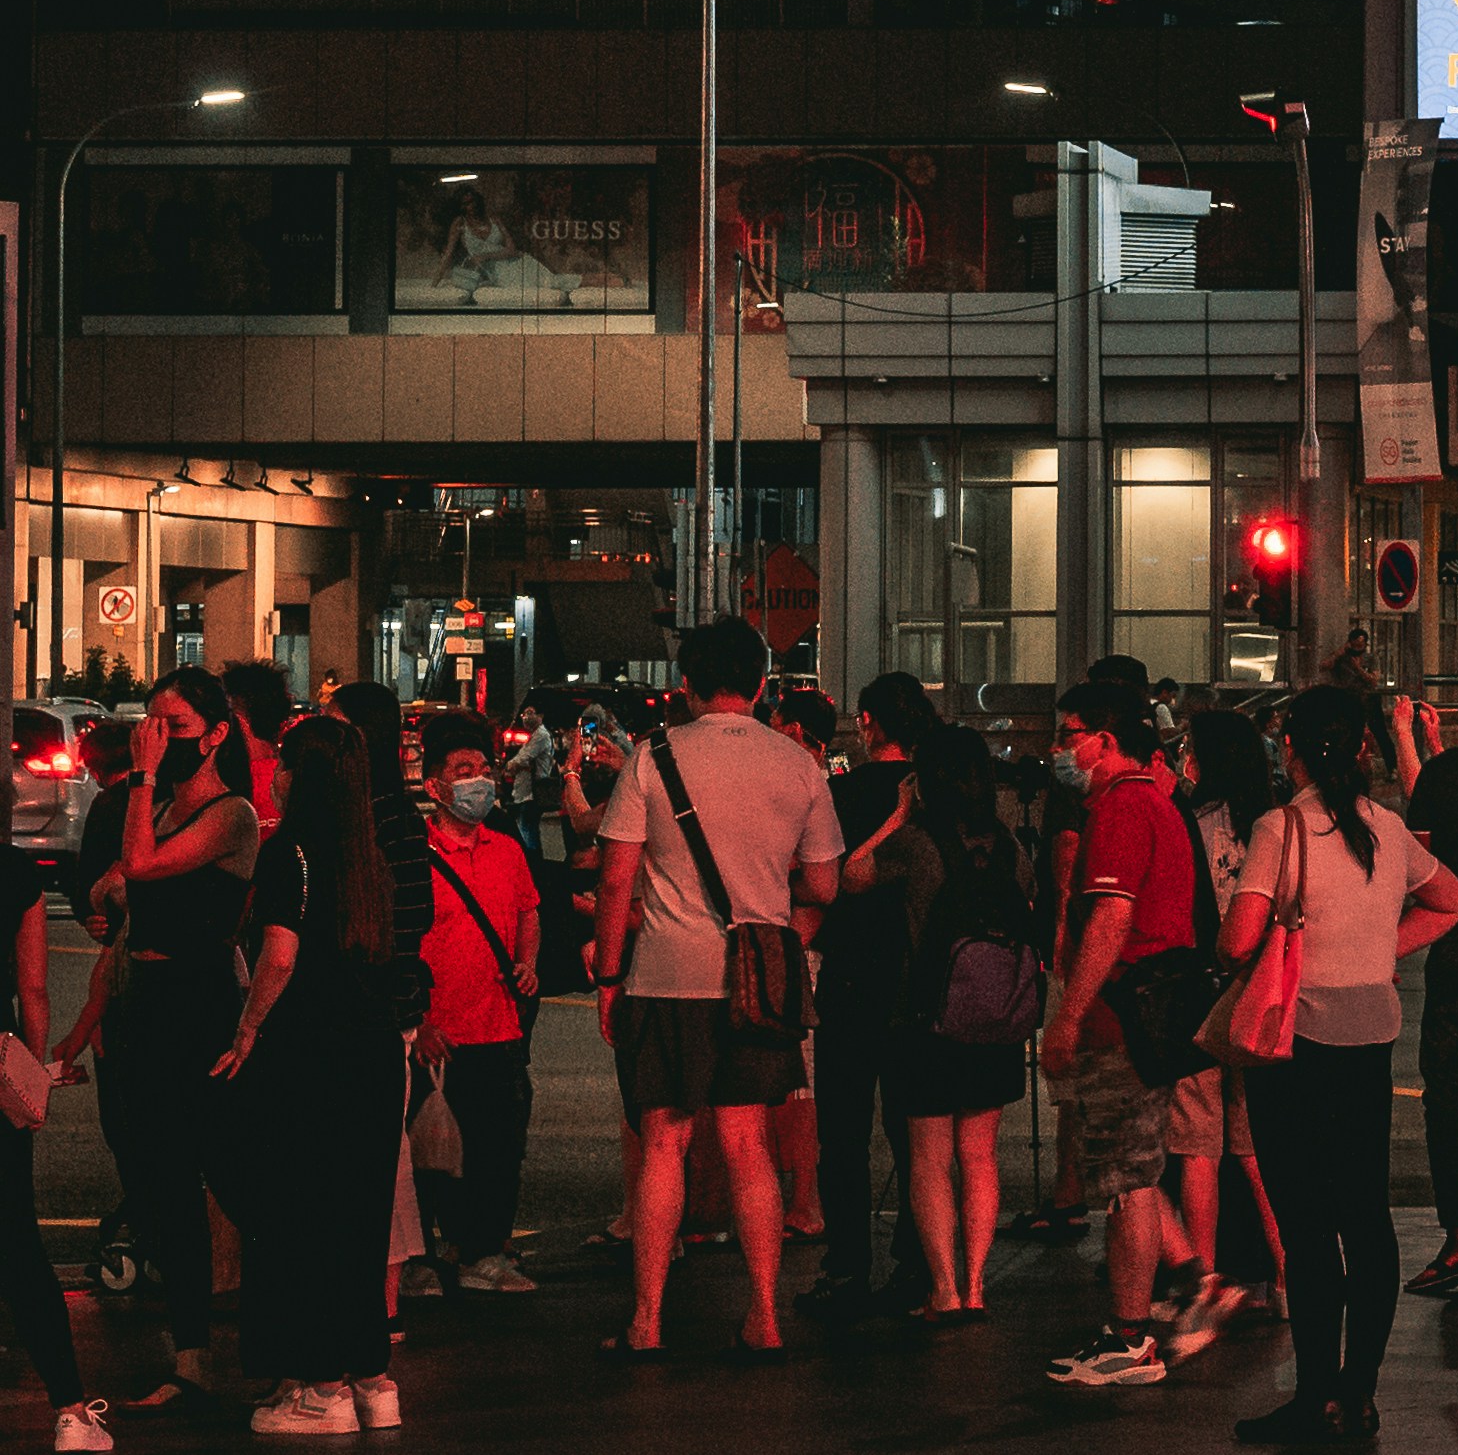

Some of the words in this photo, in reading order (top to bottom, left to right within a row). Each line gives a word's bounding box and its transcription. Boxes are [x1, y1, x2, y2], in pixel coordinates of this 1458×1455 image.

[1368, 134, 1409, 148] BESPOKE
[1368, 145, 1424, 161] EXPERIENCES
[532, 220, 621, 241] GUESS
